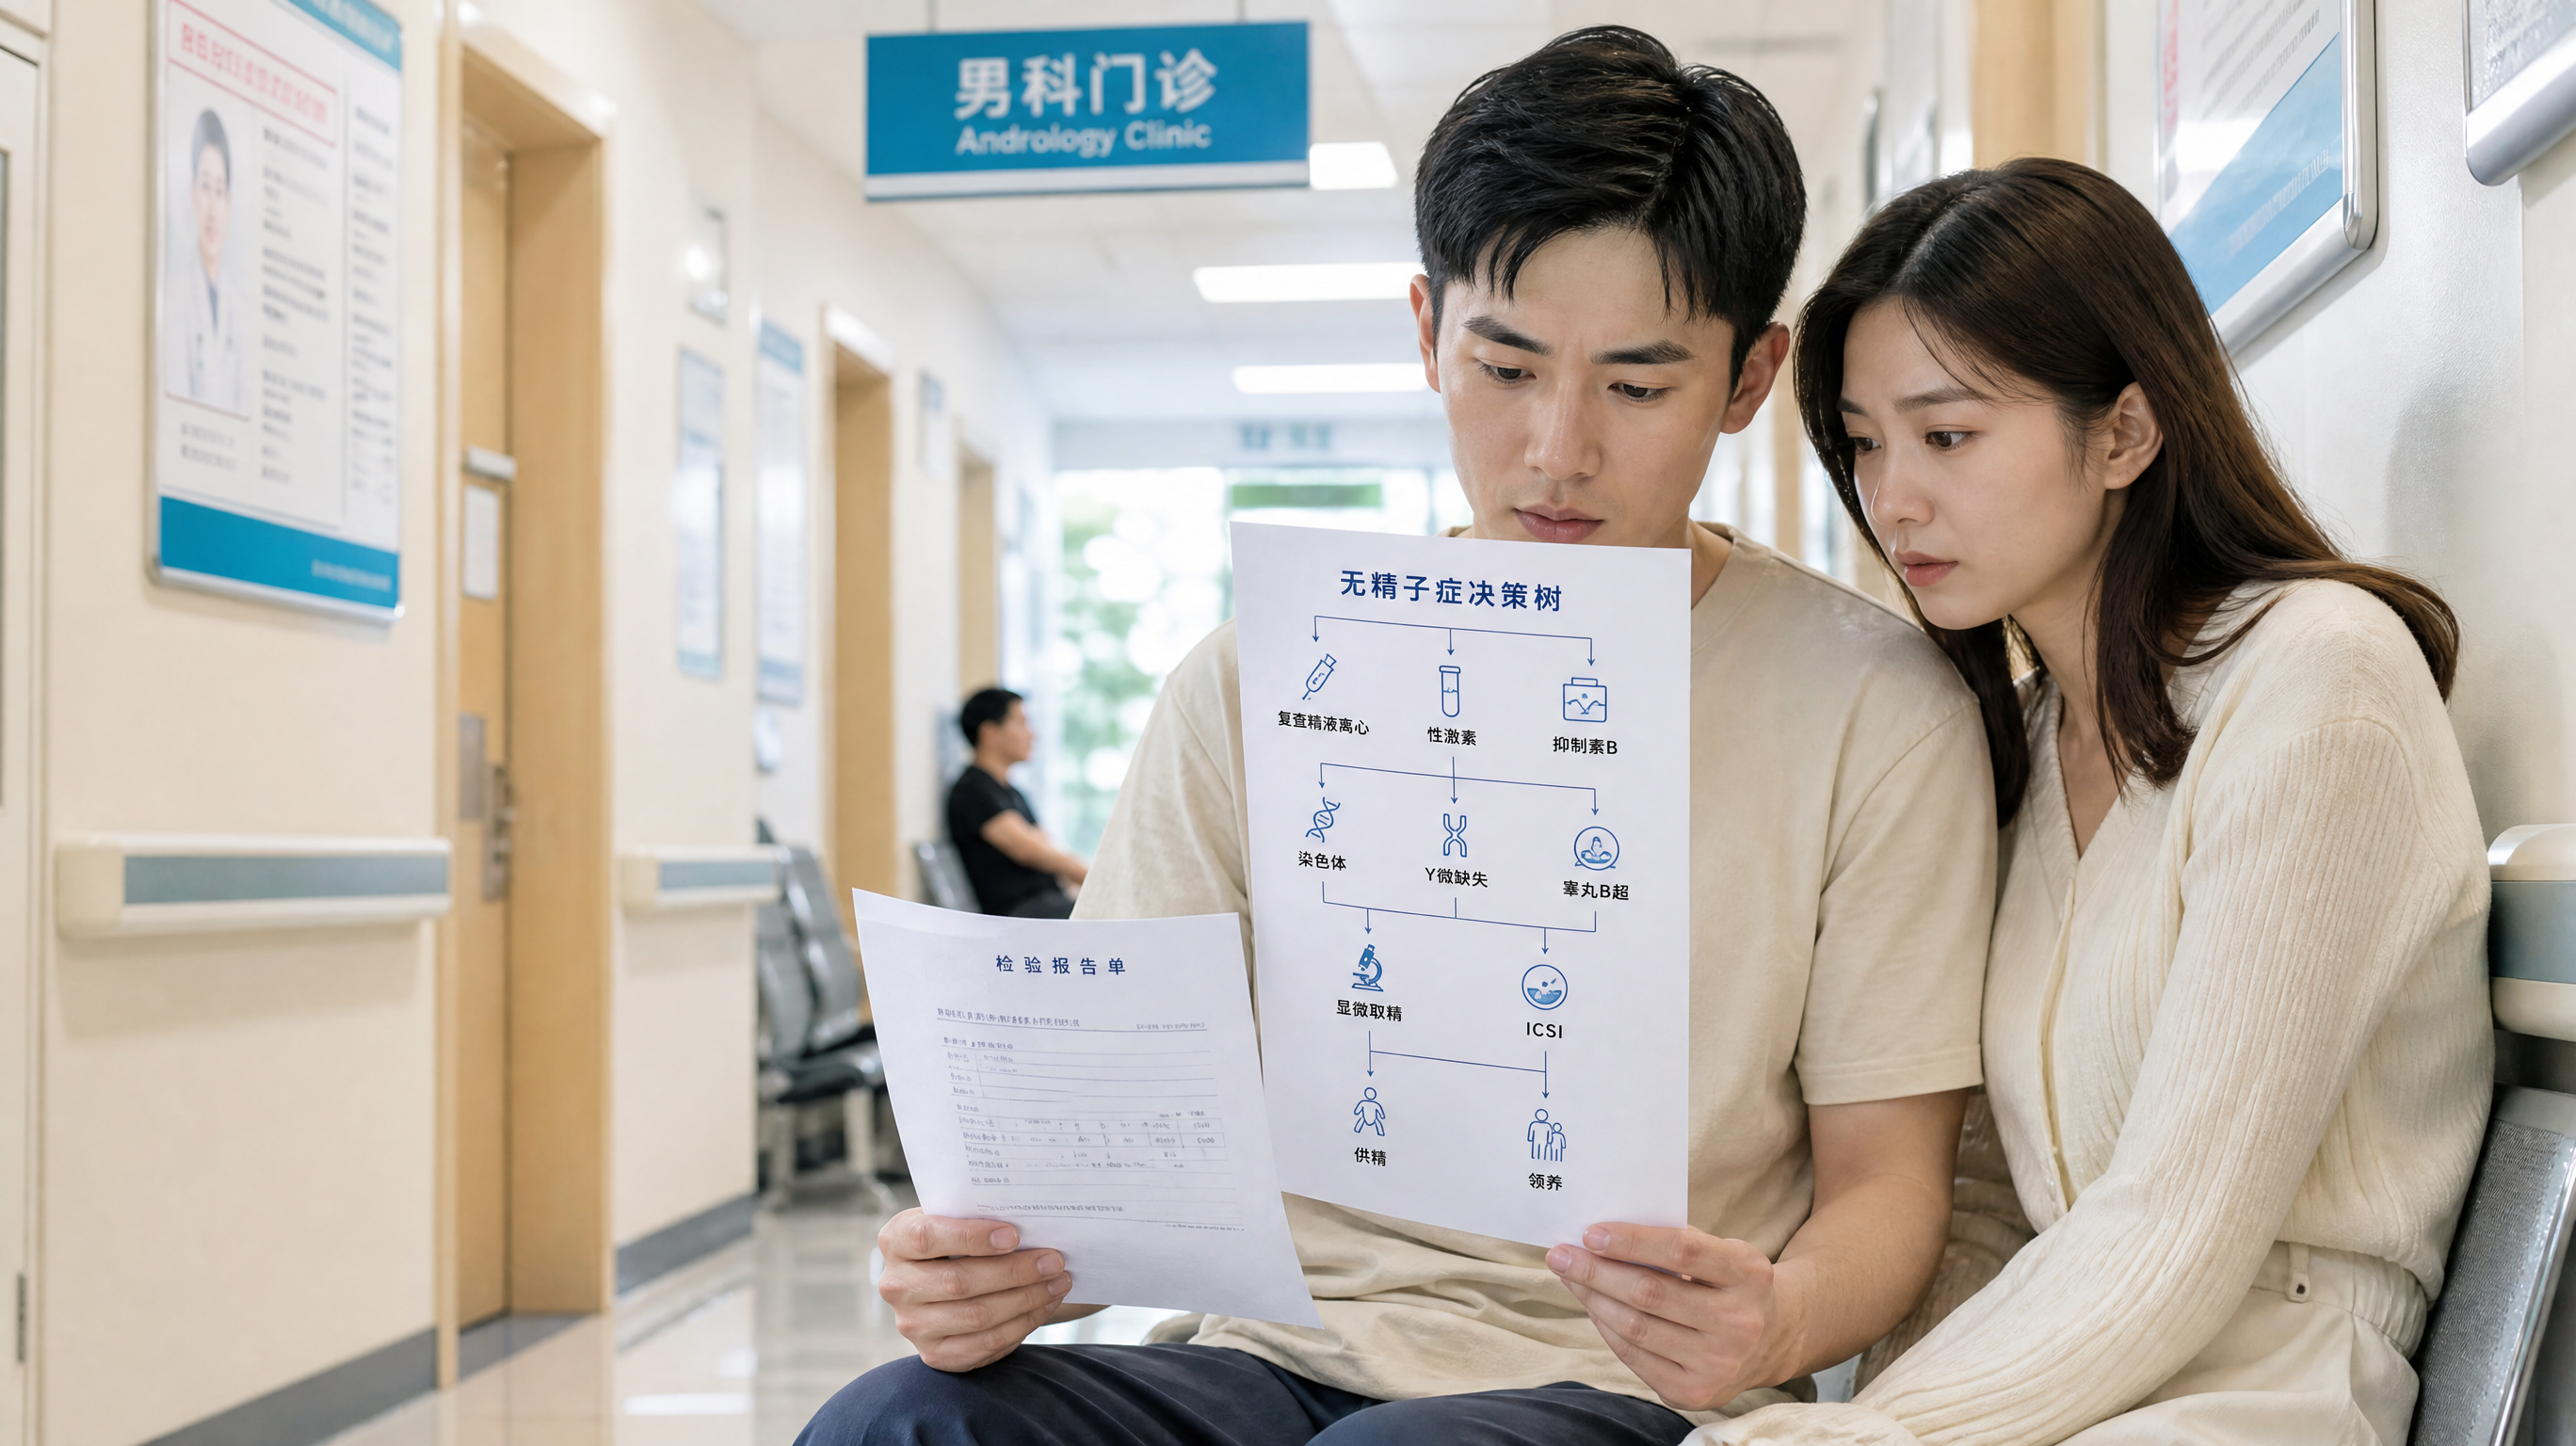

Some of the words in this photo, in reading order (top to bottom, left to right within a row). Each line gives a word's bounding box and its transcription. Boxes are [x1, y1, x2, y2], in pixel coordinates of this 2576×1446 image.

[955, 48, 1217, 120] 男科门诊
[956, 124, 1117, 157] Andrology
[1124, 120, 1212, 151] Clinic
[1340, 570, 1562, 612] 无精子症决策树
[1278, 710, 1370, 735] 复查精液离心
[1426, 726, 1477, 747] 性激素
[1552, 736, 1618, 755] 抑制素B
[1297, 850, 1347, 872] 染色体
[1425, 867, 1489, 889] Y微缺失
[995, 955, 1126, 976] 检验报告单
[1336, 999, 1403, 1022] 显微取精
[1526, 1021, 1563, 1039] ICSI
[1354, 1146, 1387, 1167] 供精
[1528, 1172, 1563, 1192] 领养
